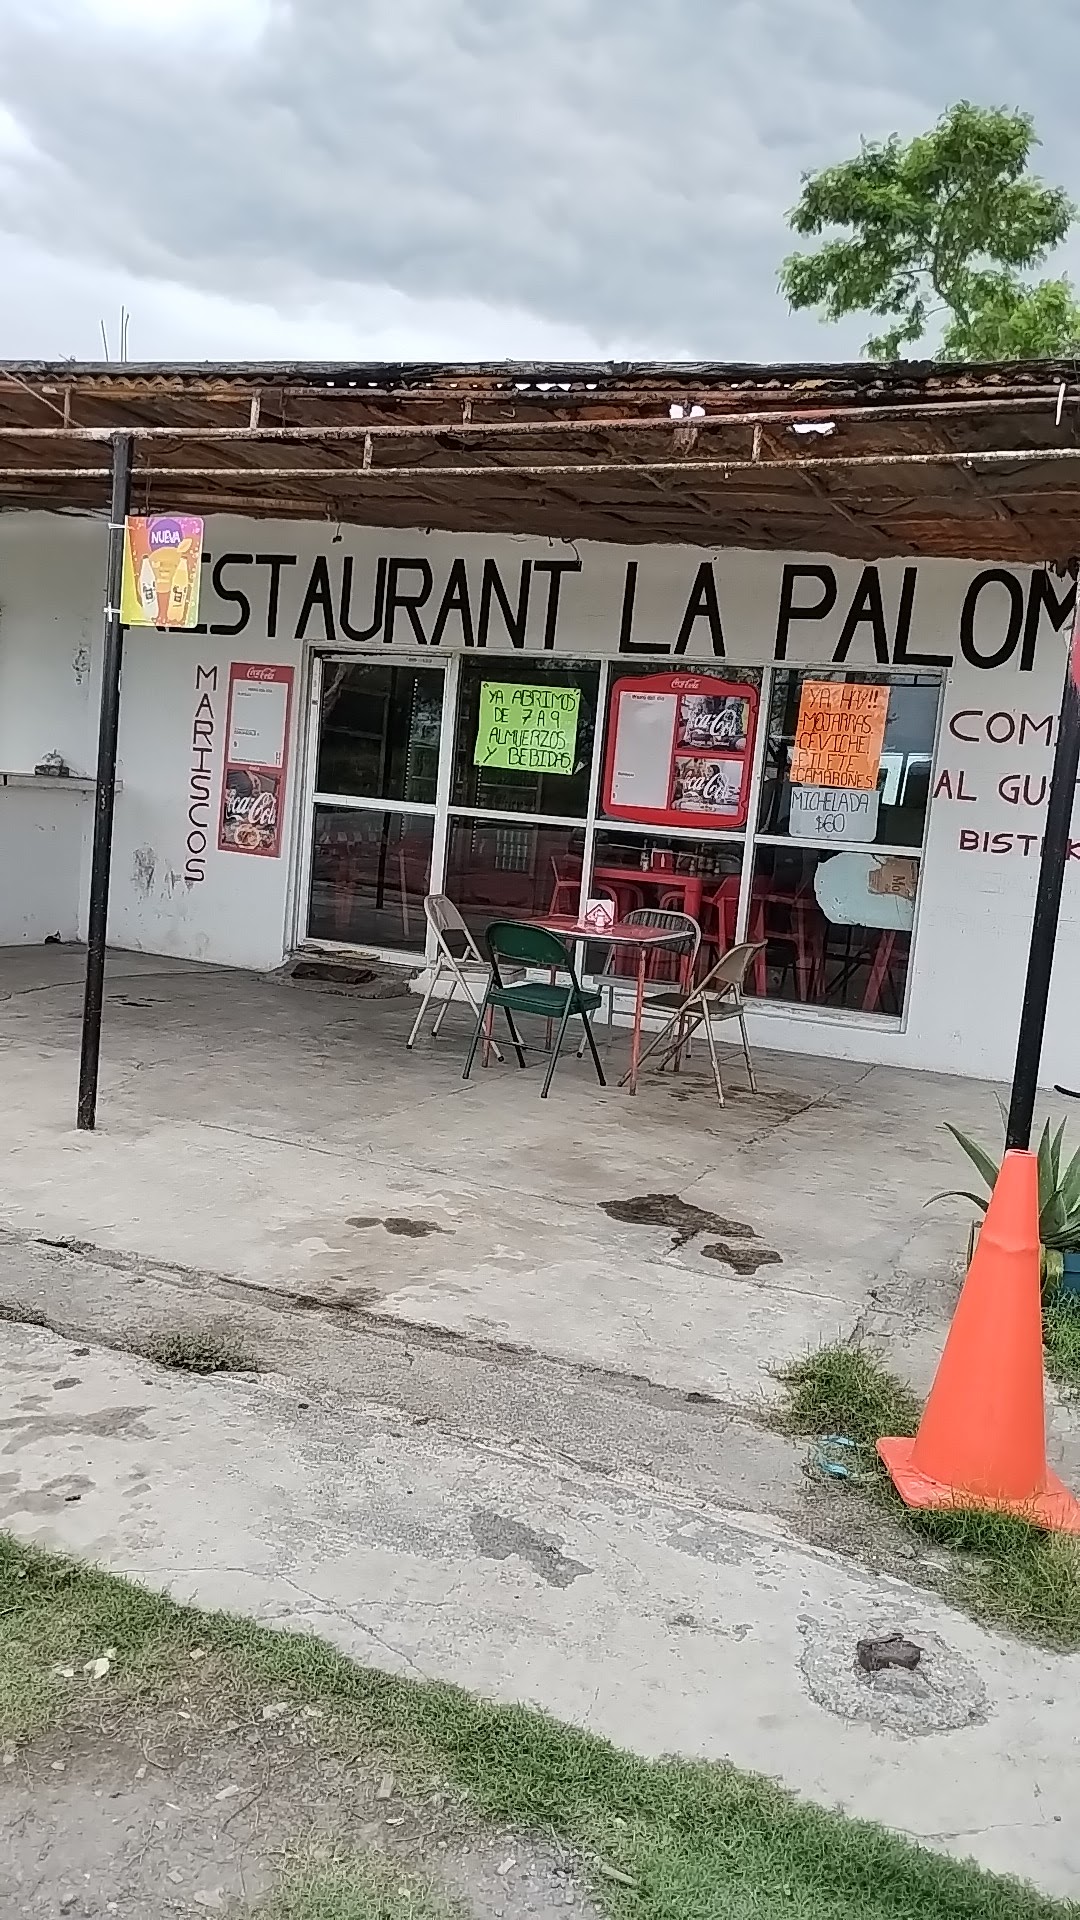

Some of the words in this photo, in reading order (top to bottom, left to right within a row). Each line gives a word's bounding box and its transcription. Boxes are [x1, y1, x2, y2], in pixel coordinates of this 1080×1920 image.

[151, 530, 180, 544] NUEVA
[619, 562, 725, 657] LA
[489, 690, 504, 704] YA
[512, 690, 576, 712] ABRIMOS
[810, 688, 830, 708] YA
[494, 707, 510, 723] DE
[522, 709, 533, 725] 7
[537, 710, 545, 726] A
[550, 711, 560, 728] 9
[489, 727, 566, 749] ALMUERZOS
[483, 746, 497, 763] Y
[508, 747, 571, 768] BEBIDAS
[184, 665, 217, 882] MARISCOS
[933, 770, 977, 801] AL
[791, 791, 869, 813] MICHELADA
[815, 814, 846, 833] $60
